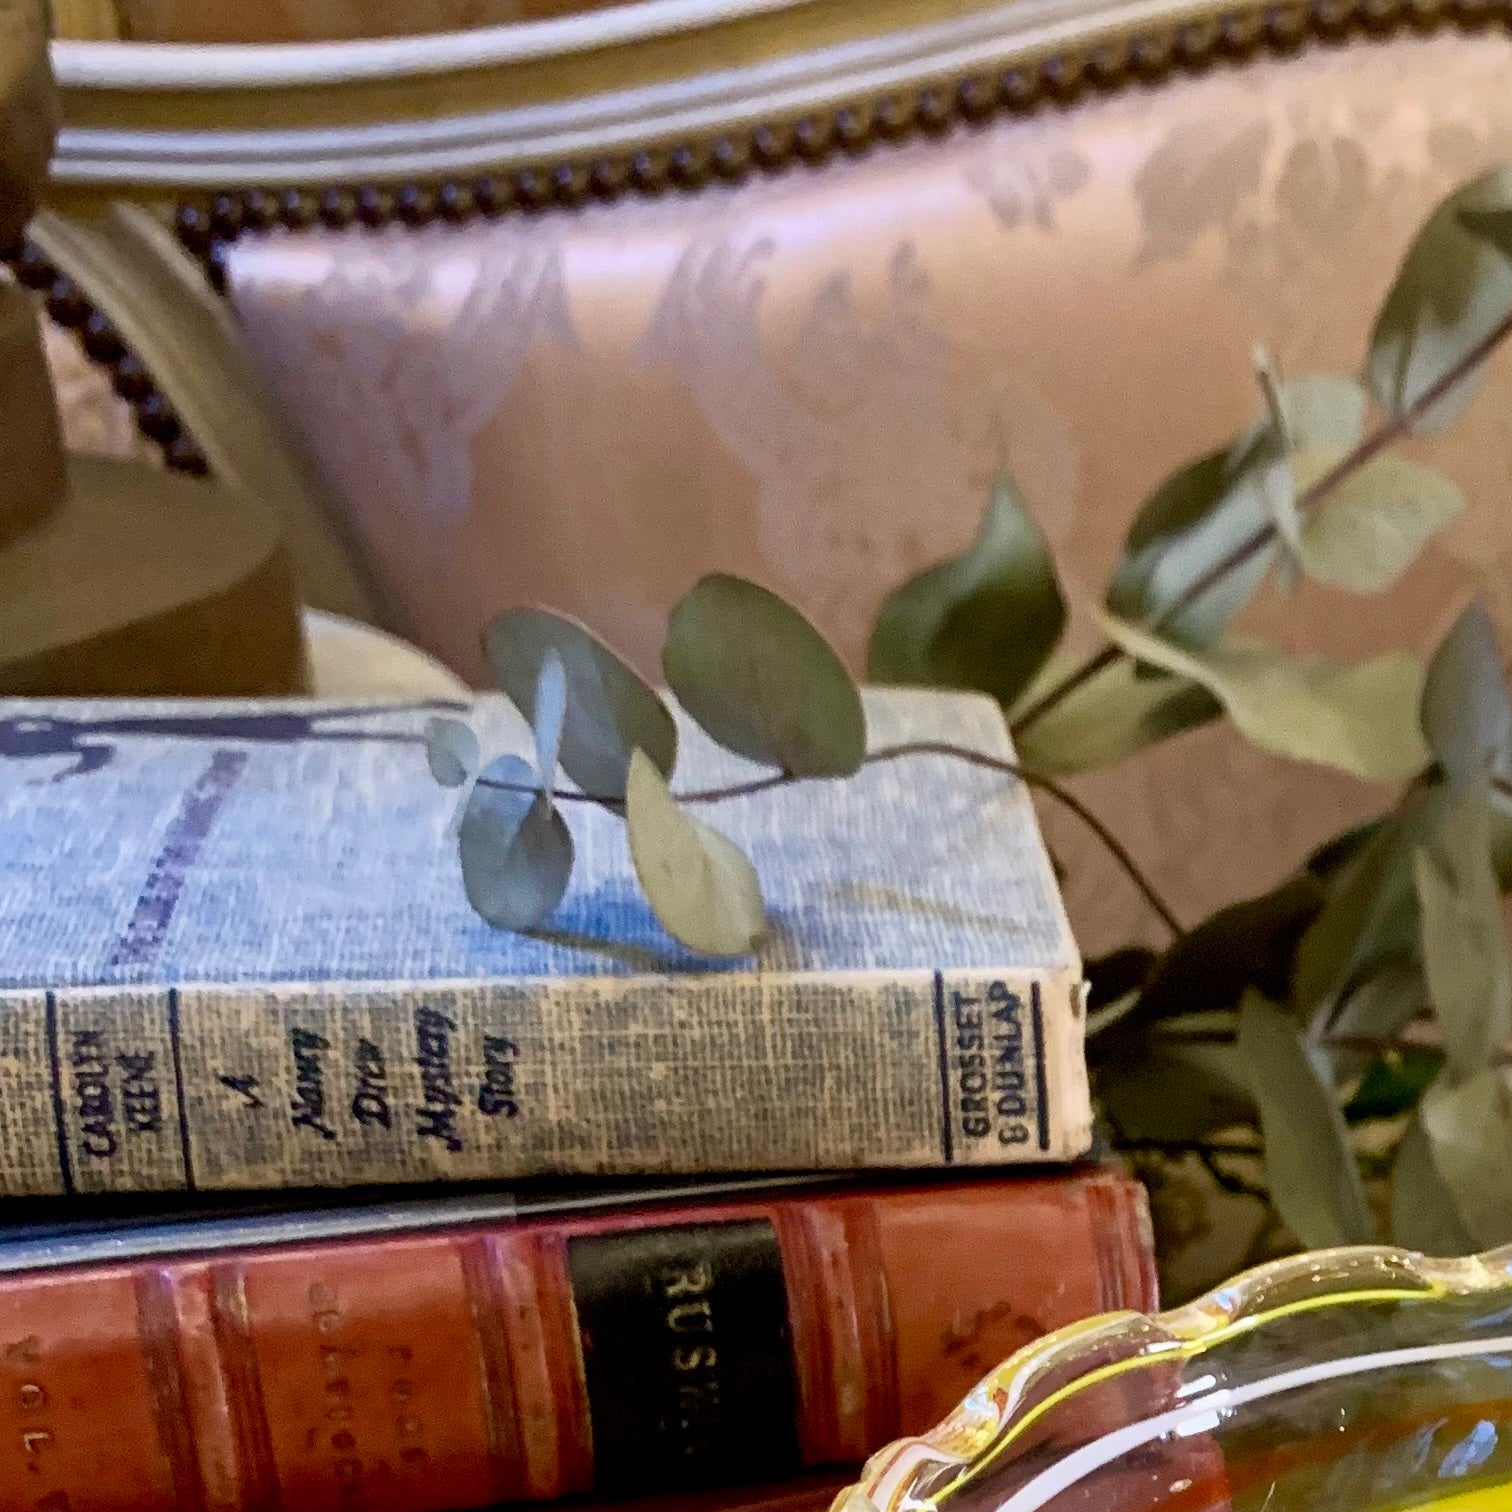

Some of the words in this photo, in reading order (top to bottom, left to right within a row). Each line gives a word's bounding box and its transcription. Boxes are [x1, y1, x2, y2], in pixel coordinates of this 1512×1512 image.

[217, 1072, 265, 1110] A
[290, 1028, 336, 1142] Nancy
[351, 1036, 392, 1131] Drew
[476, 1034, 521, 1120] Story
[955, 992, 990, 1138] GROSSET
[988, 980, 1026, 1116] DUNLAP
